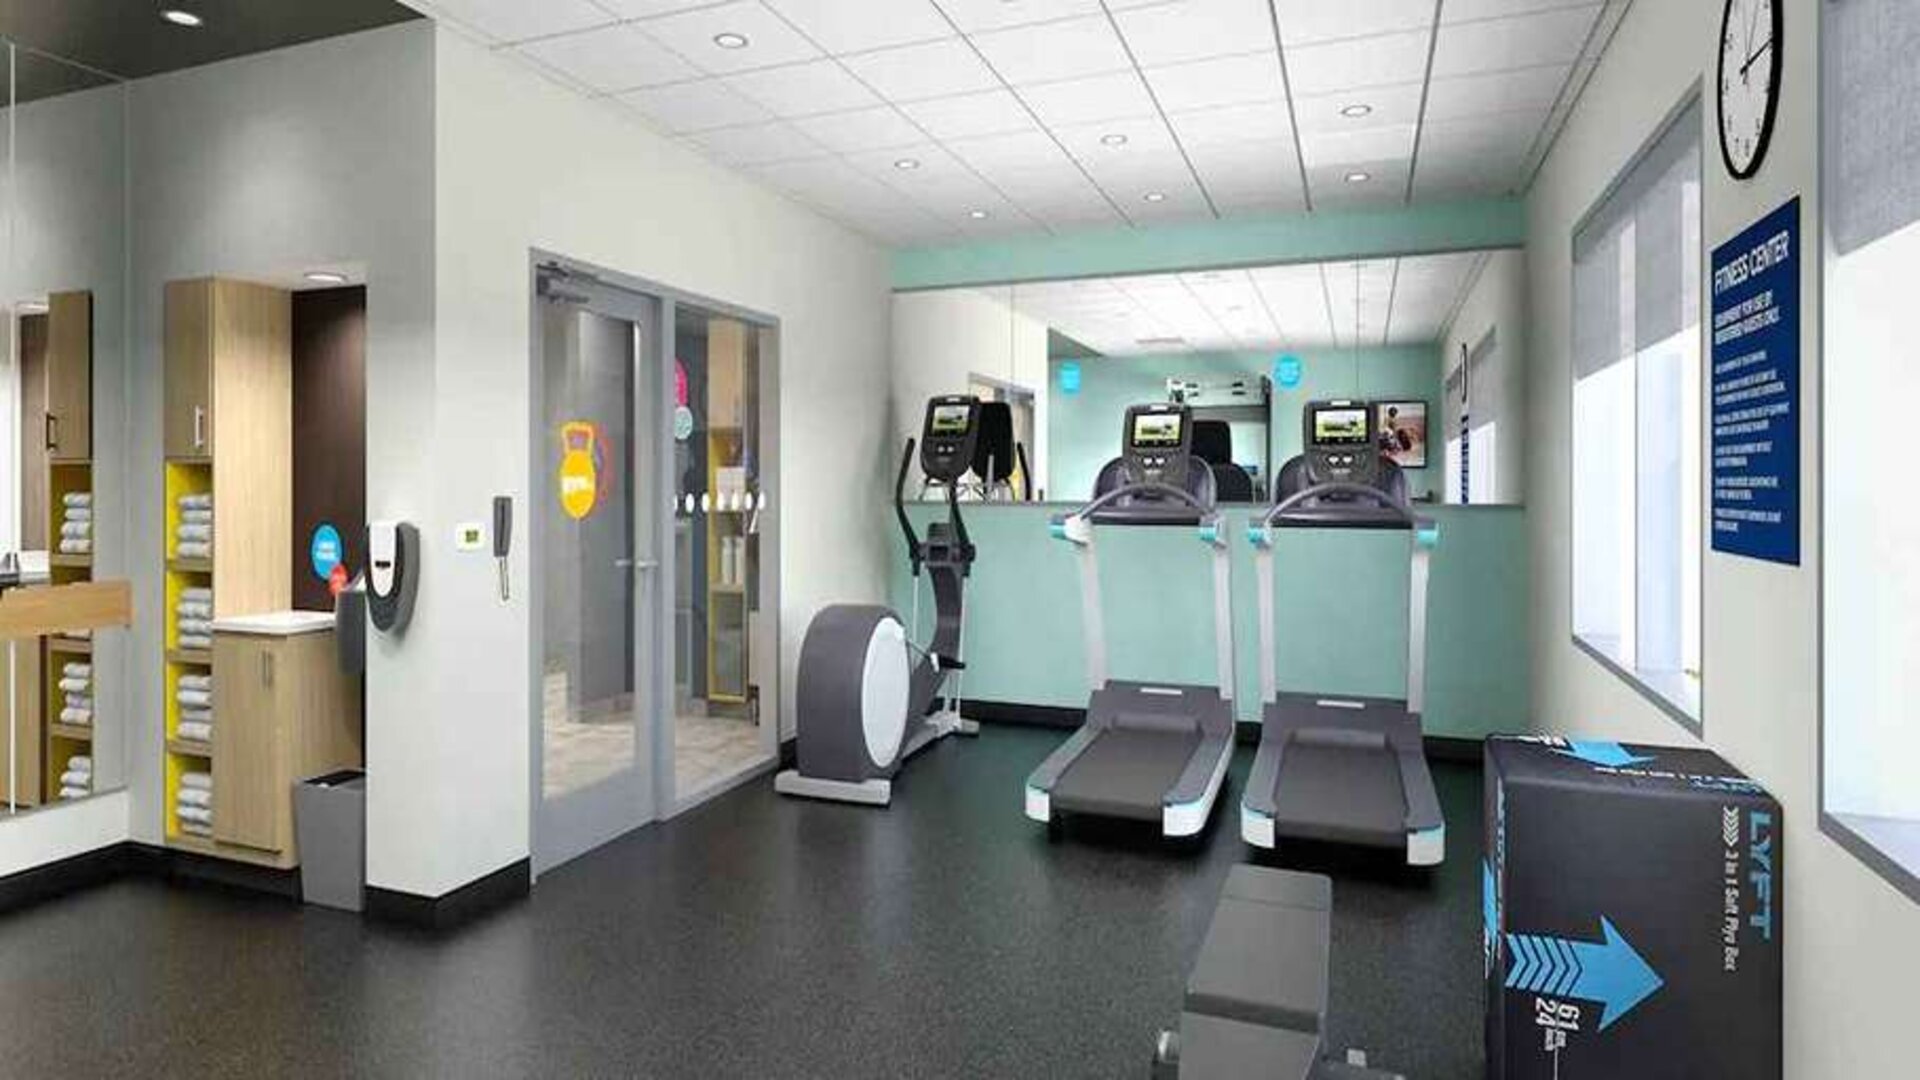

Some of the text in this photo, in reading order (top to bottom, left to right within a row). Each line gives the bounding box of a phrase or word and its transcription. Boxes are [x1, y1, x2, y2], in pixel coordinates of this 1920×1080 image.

[1714, 229, 1789, 296] FITNESS CENTER
[1750, 810, 1772, 939] LYFT
[1724, 886, 1740, 915] Soft
[1535, 997, 1557, 1027] 24
[1558, 1003, 1580, 1031] 61
